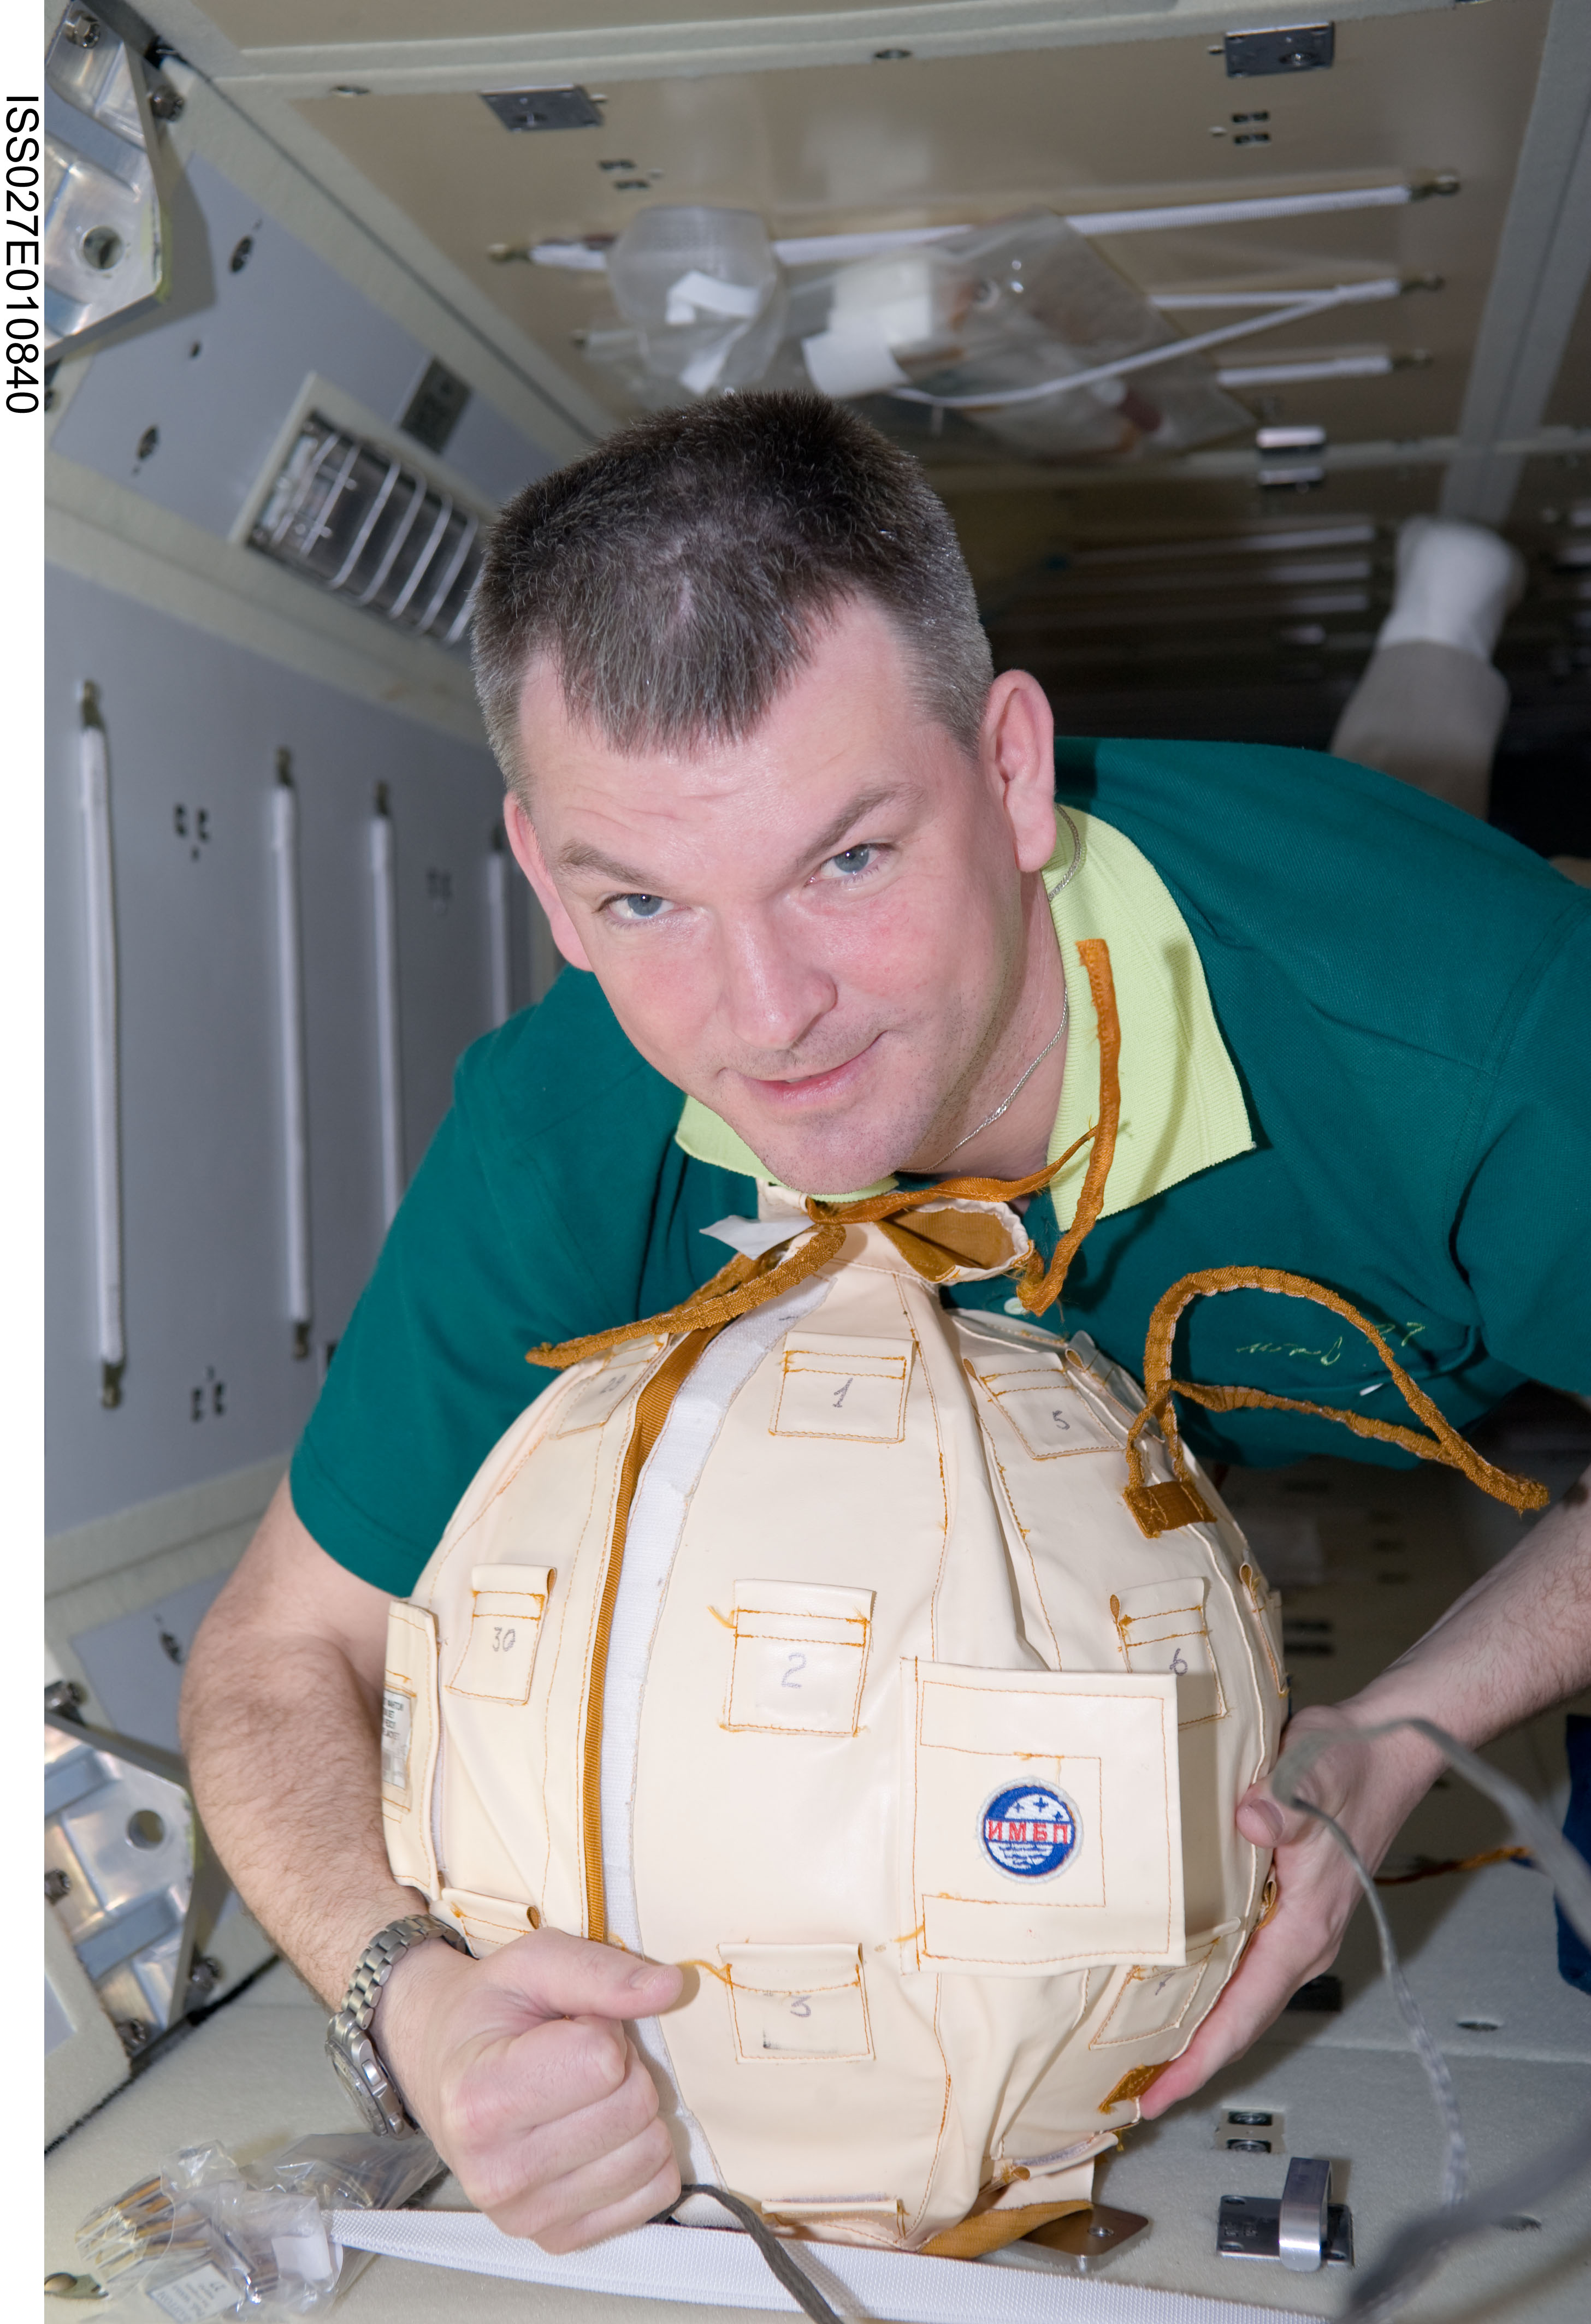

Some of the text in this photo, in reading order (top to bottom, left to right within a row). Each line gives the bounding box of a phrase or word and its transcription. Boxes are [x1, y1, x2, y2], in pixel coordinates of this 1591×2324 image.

[599, 1374, 626, 1394] 29
[832, 1377, 854, 1408] 1
[1052, 1410, 1070, 1430] 5
[492, 1627, 516, 1651] 30
[781, 1652, 807, 1688] 2
[1169, 1647, 1188, 1676] 6
[987, 1819, 1068, 1845] ИМБП
[790, 1994, 812, 2018] 3
